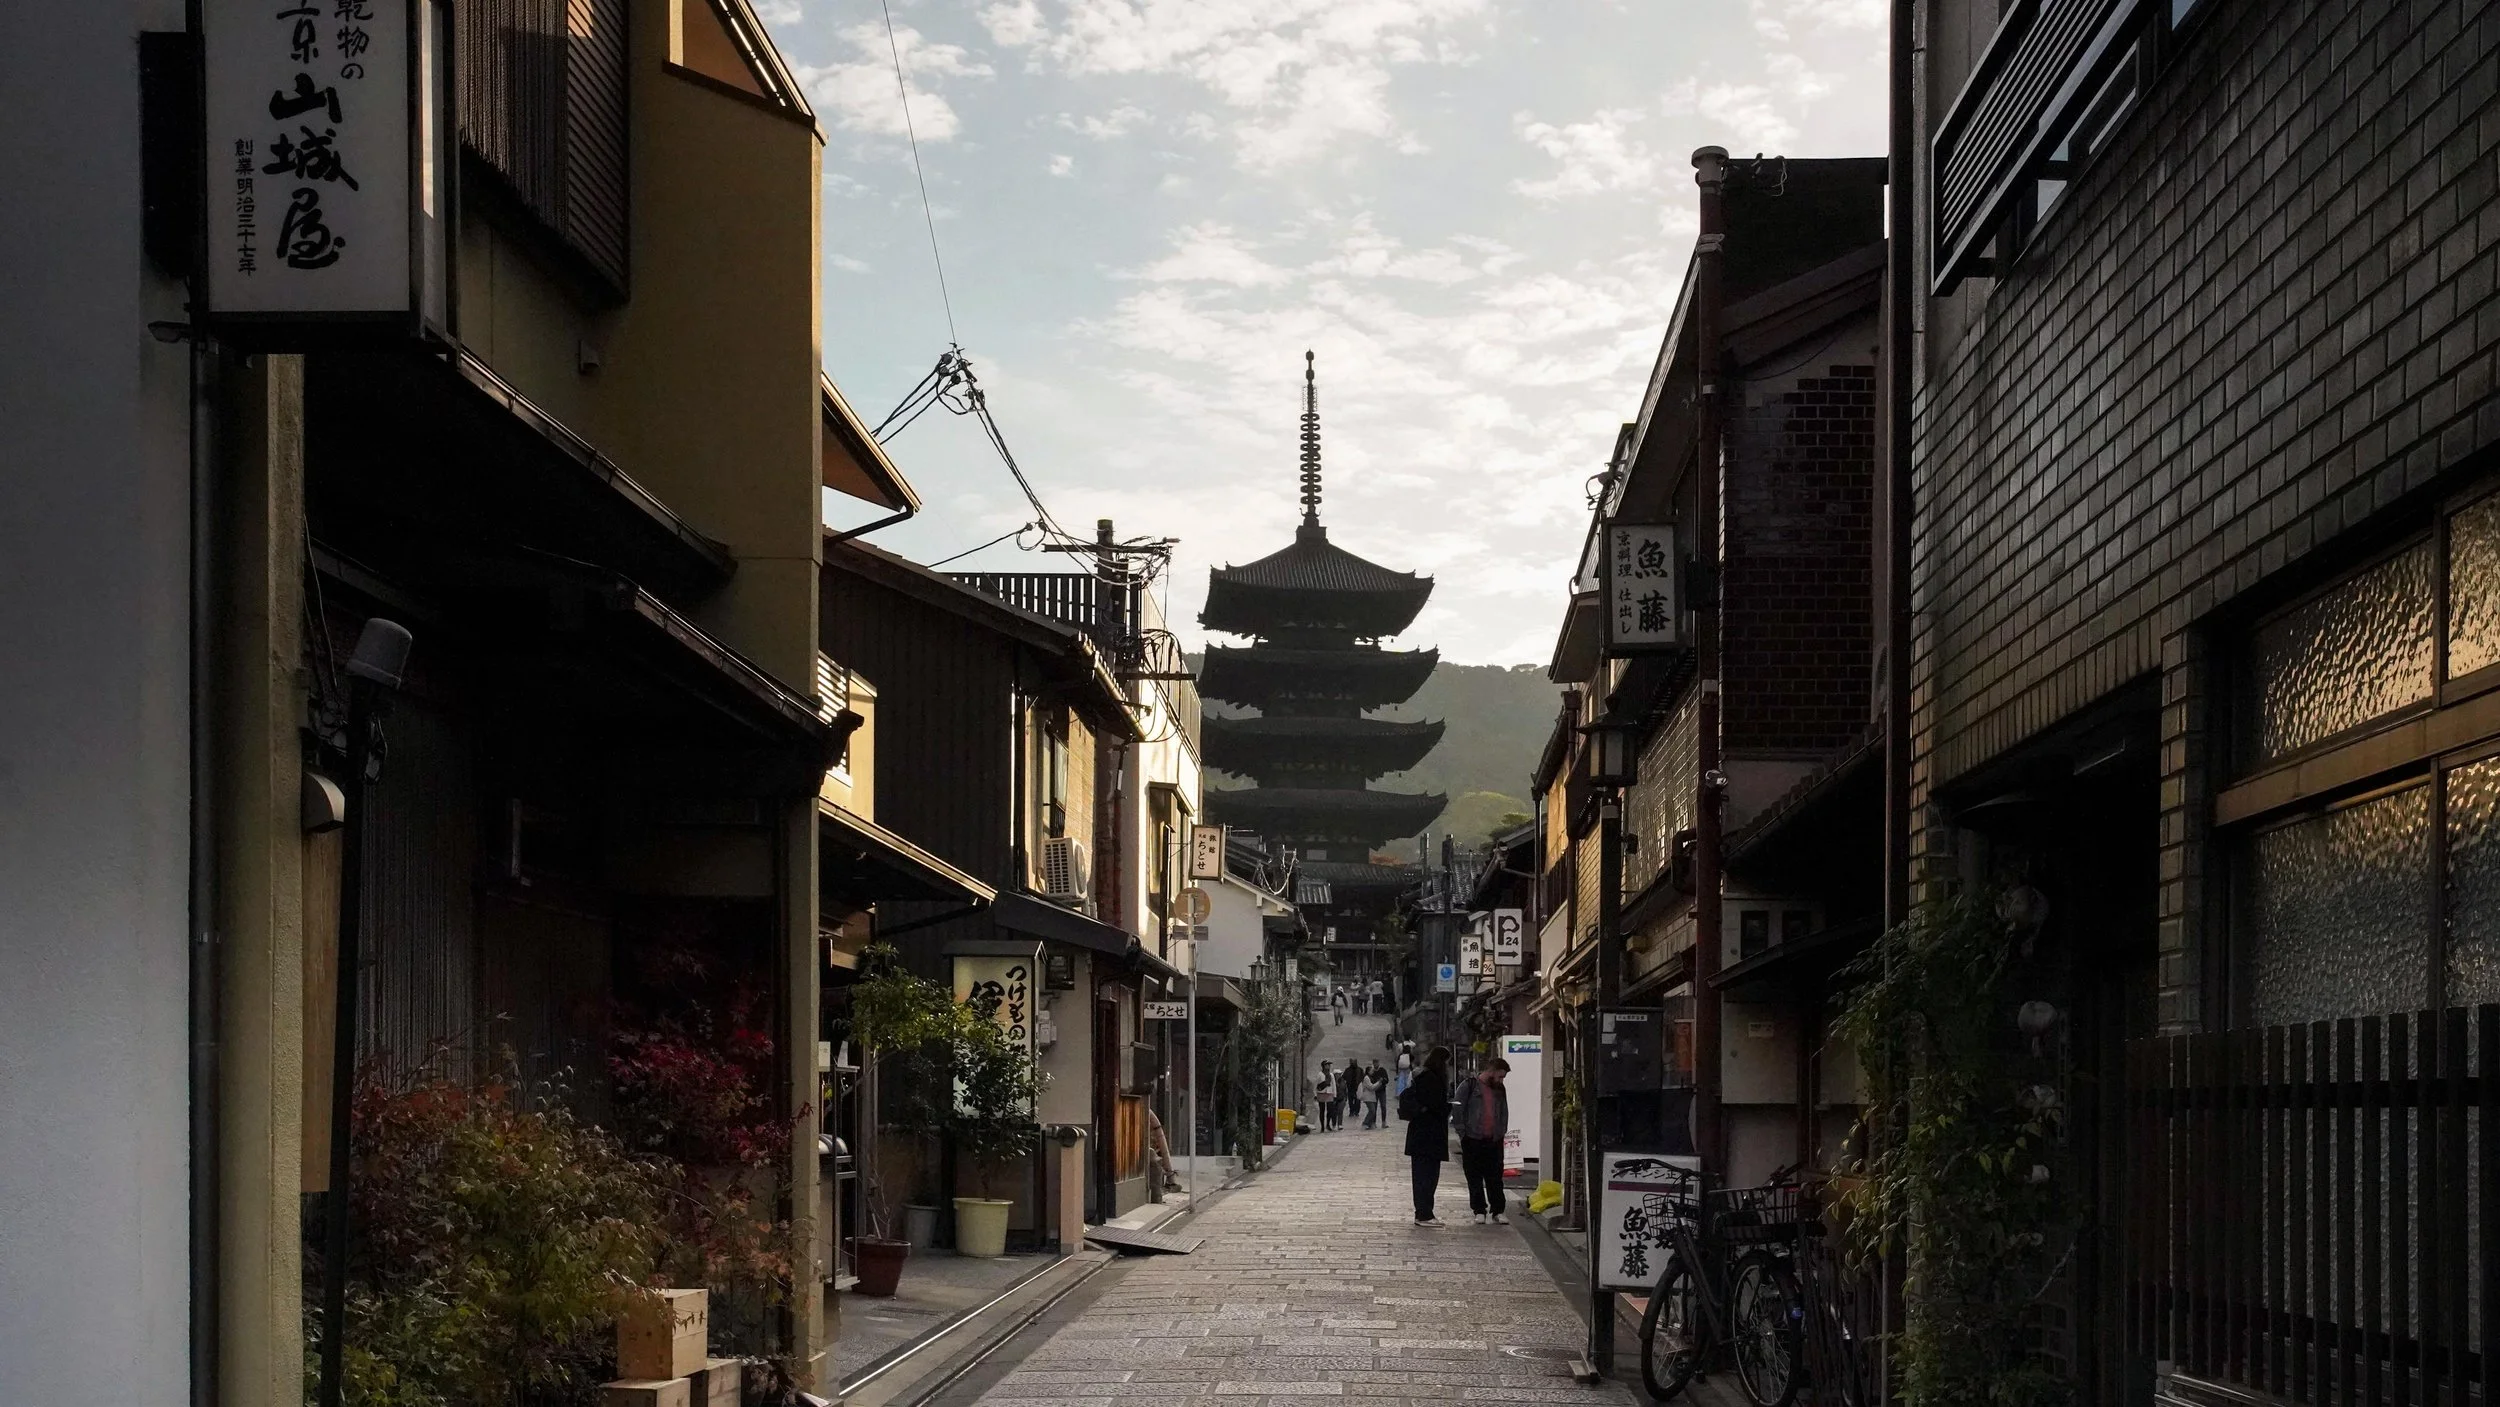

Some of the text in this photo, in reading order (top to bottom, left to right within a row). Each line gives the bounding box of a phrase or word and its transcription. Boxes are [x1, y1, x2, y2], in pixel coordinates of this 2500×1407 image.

[334, 0, 374, 80] 乾物の
[234, 138, 257, 277] 創業明治三十七年
[1634, 538, 1671, 634] 魚藤
[1197, 841, 1207, 870] ちとせ
[1497, 915, 1520, 946] P 24
[1156, 1004, 1185, 1017] ちとせ
[1618, 1205, 1652, 1280] 魚藤
